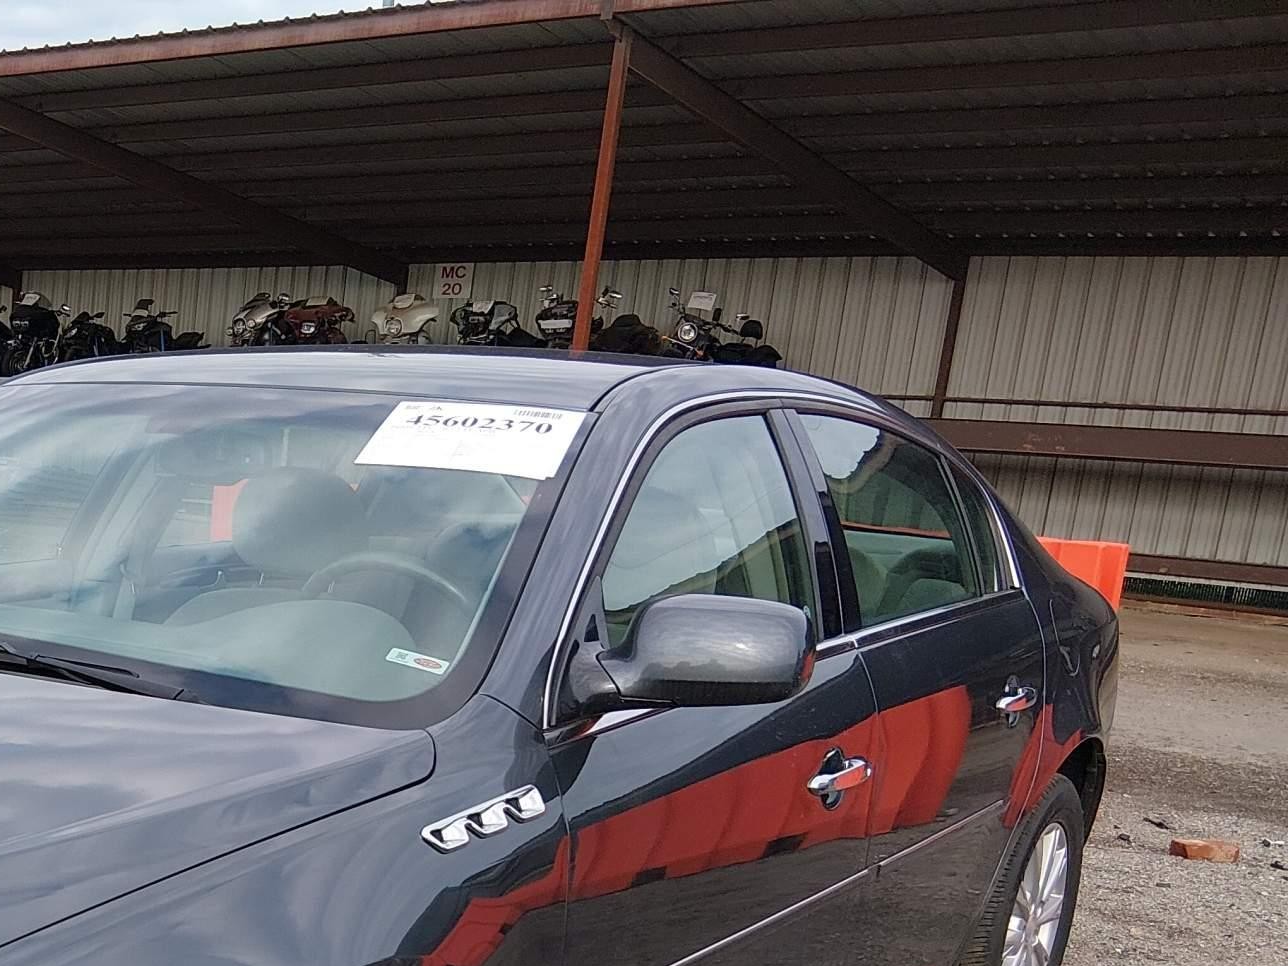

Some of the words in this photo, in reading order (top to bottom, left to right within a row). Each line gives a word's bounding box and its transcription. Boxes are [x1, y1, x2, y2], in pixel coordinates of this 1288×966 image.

[441, 265, 467, 279] MC
[441, 282, 463, 296] 20
[406, 414, 554, 435] 45602370
